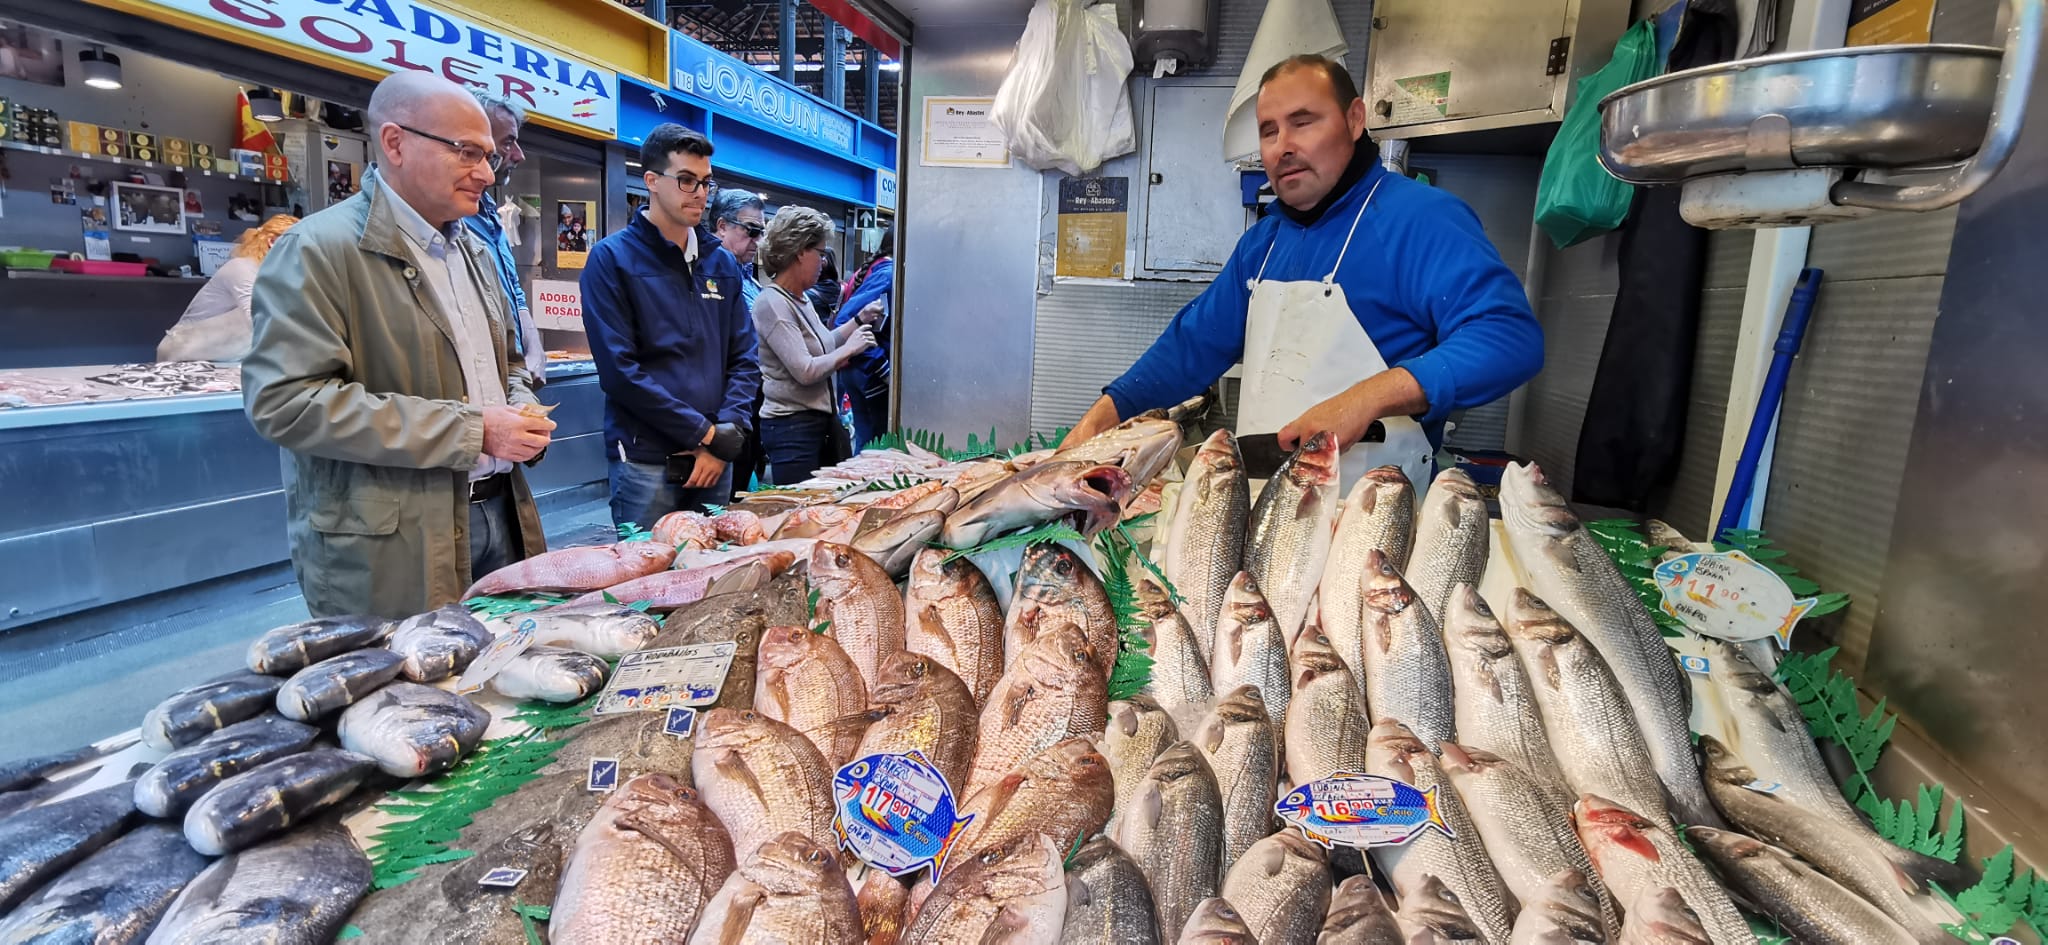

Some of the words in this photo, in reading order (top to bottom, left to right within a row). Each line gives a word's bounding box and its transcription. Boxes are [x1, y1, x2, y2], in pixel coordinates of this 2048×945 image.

[314, 0, 610, 99] ADERIA
[698, 59, 819, 135] JOAQUIN
[540, 292, 576, 303] ADOBO
